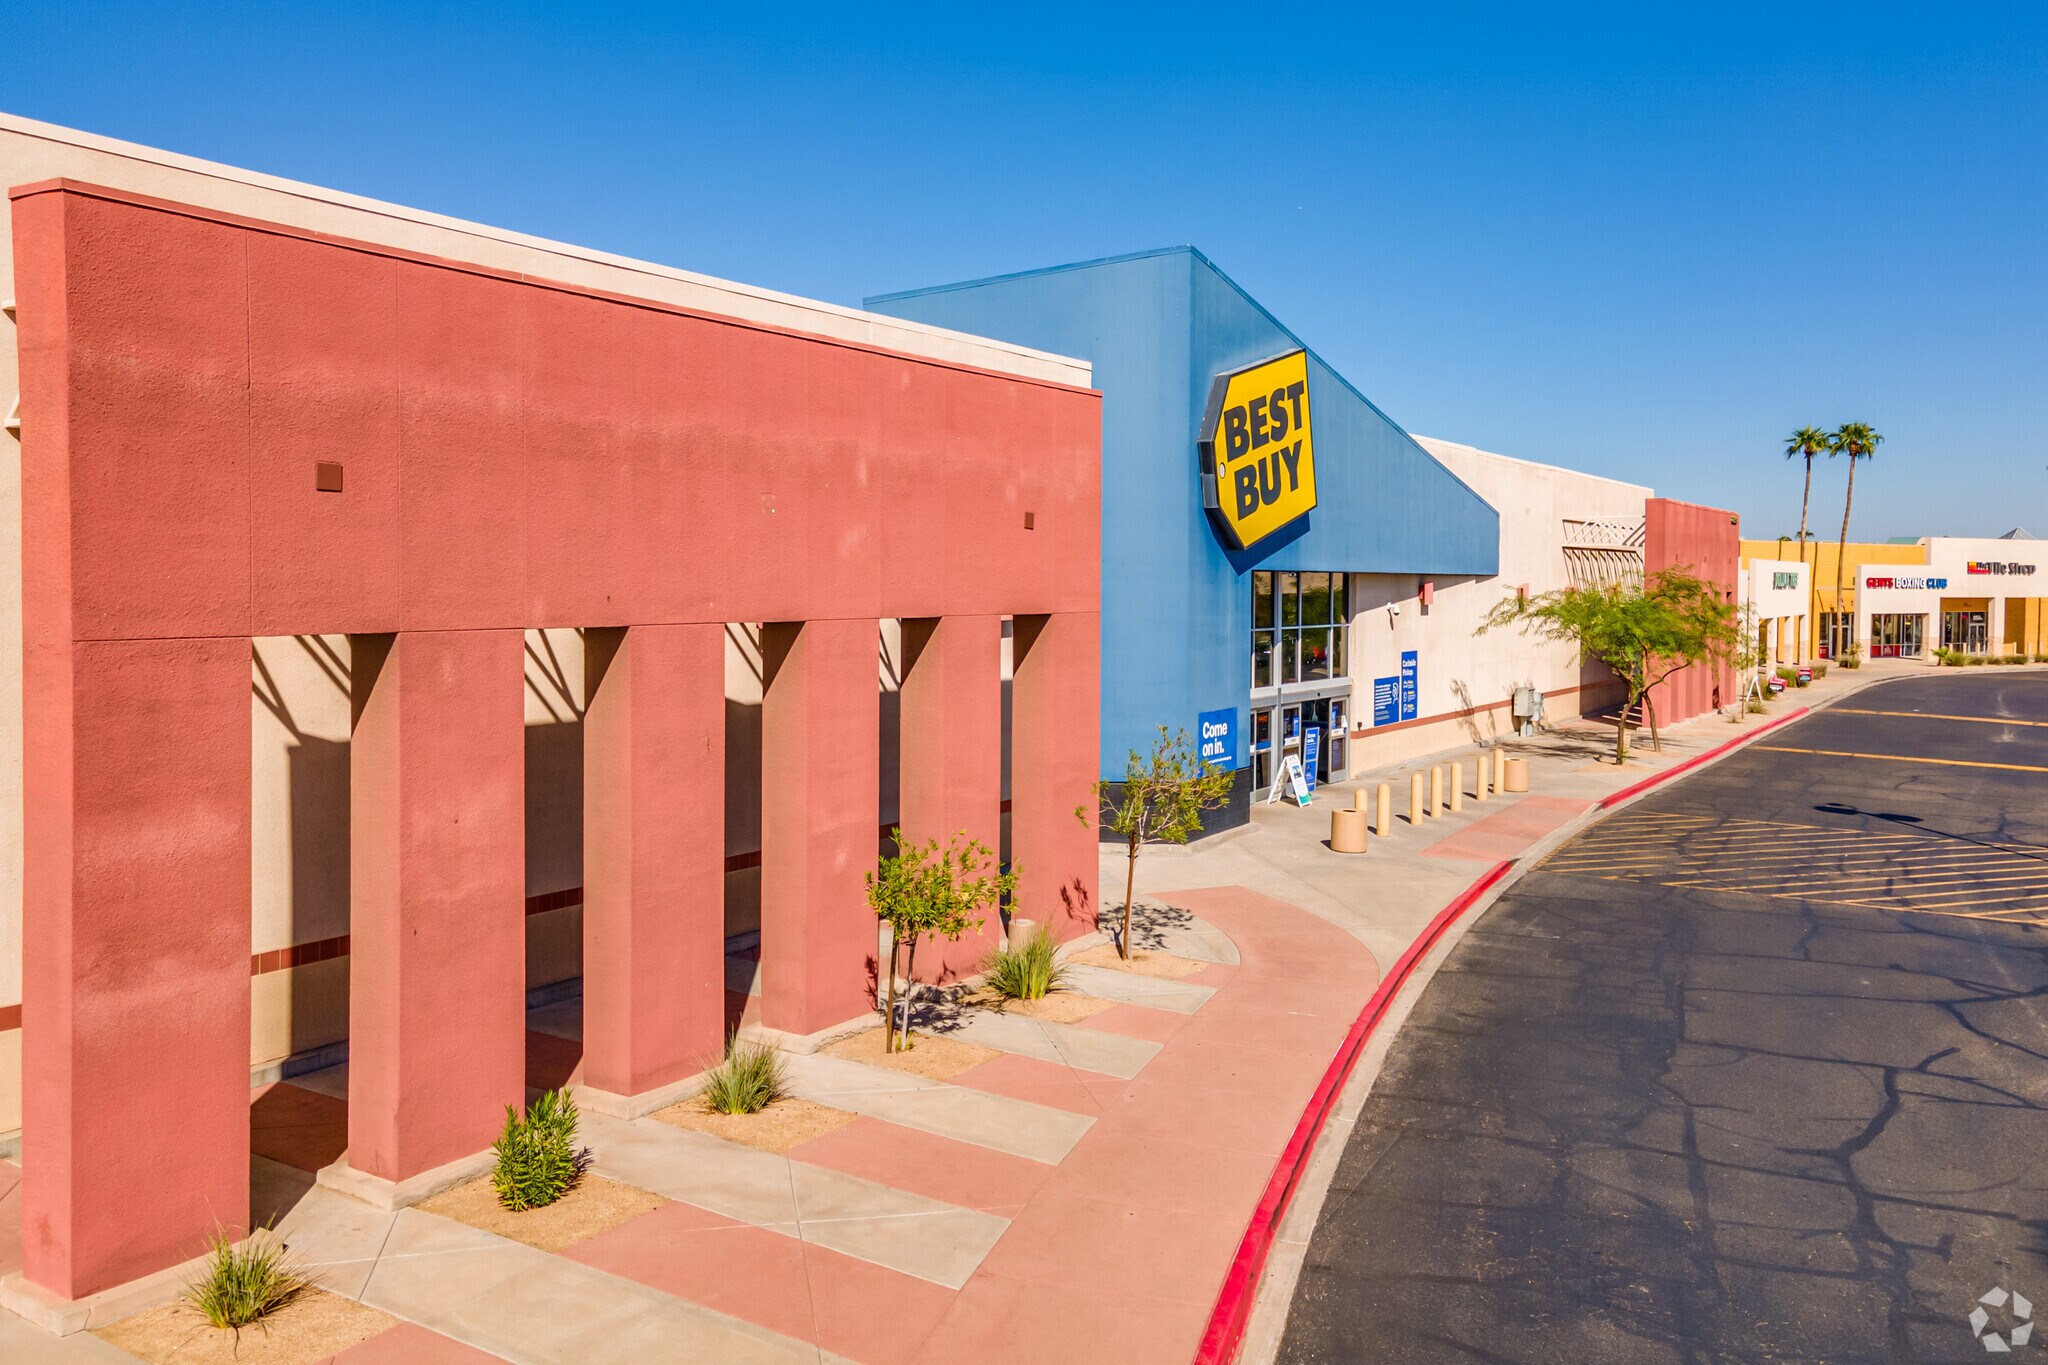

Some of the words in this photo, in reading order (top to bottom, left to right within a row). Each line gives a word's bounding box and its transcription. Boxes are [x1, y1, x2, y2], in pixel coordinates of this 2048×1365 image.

[1224, 380, 1304, 462] BEST
[1234, 439, 1302, 521] BUY
[2008, 562, 2036, 576] Shop
[1894, 577, 1925, 589] BOXING
[1926, 577, 1947, 589] CLUB
[1202, 721, 1228, 739] Come
[1202, 742, 1214, 757] on
[1214, 738, 1225, 755] in.
